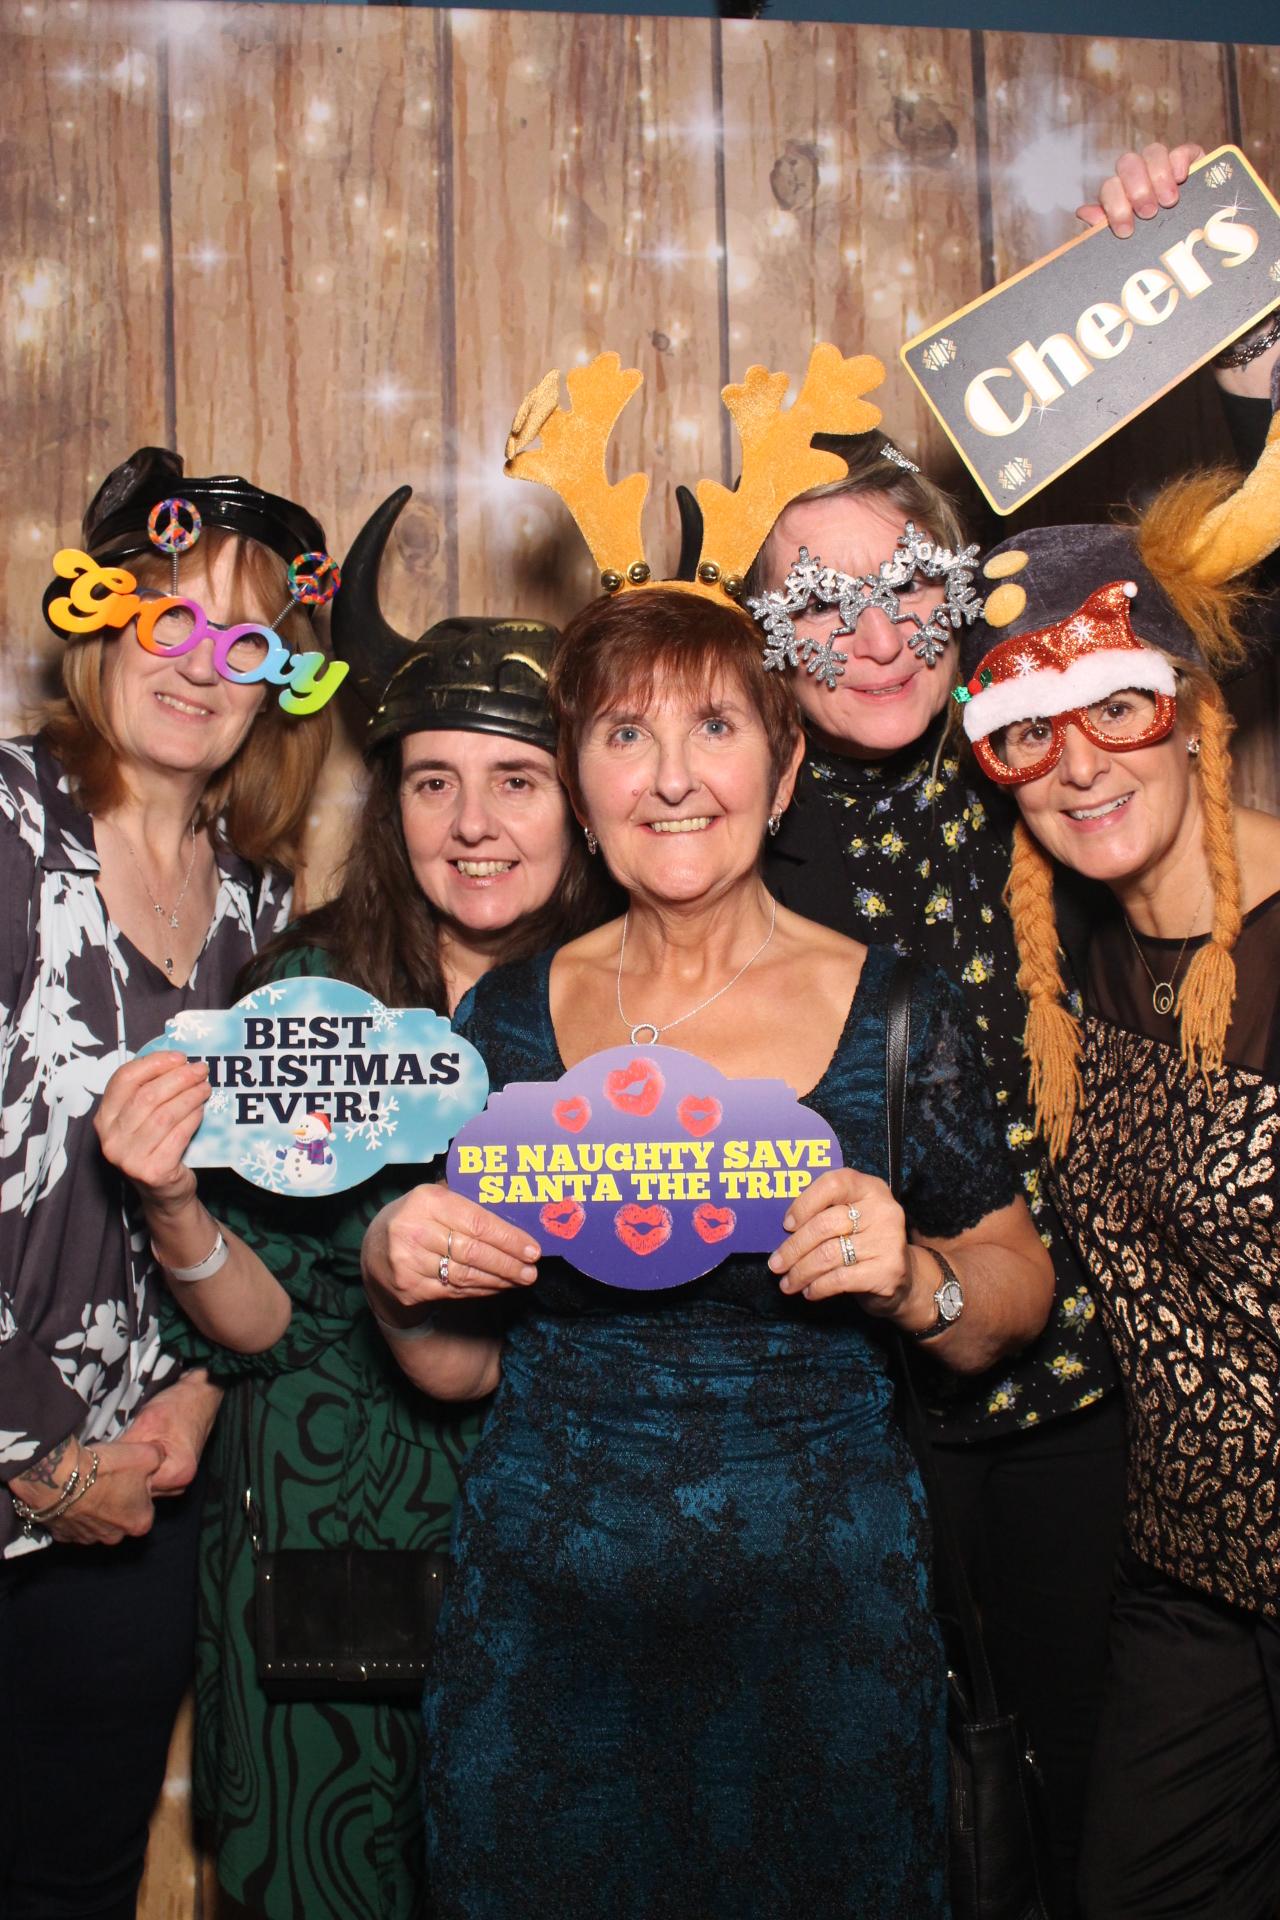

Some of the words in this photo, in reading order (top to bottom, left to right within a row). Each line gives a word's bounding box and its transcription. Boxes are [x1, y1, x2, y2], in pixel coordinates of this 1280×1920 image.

[965, 206, 1260, 437] Cheers
[244, 1016, 374, 1049] BEST
[187, 1052, 460, 1088] HRISTMAS
[235, 1091, 381, 1124] EVER!
[457, 1145, 508, 1173] BE
[516, 1141, 714, 1172] NAUGHTY
[723, 1139, 832, 1168] SAVE
[478, 1171, 623, 1204] SANTA
[633, 1171, 711, 1201] THE
[719, 1170, 812, 1199] TRIP
